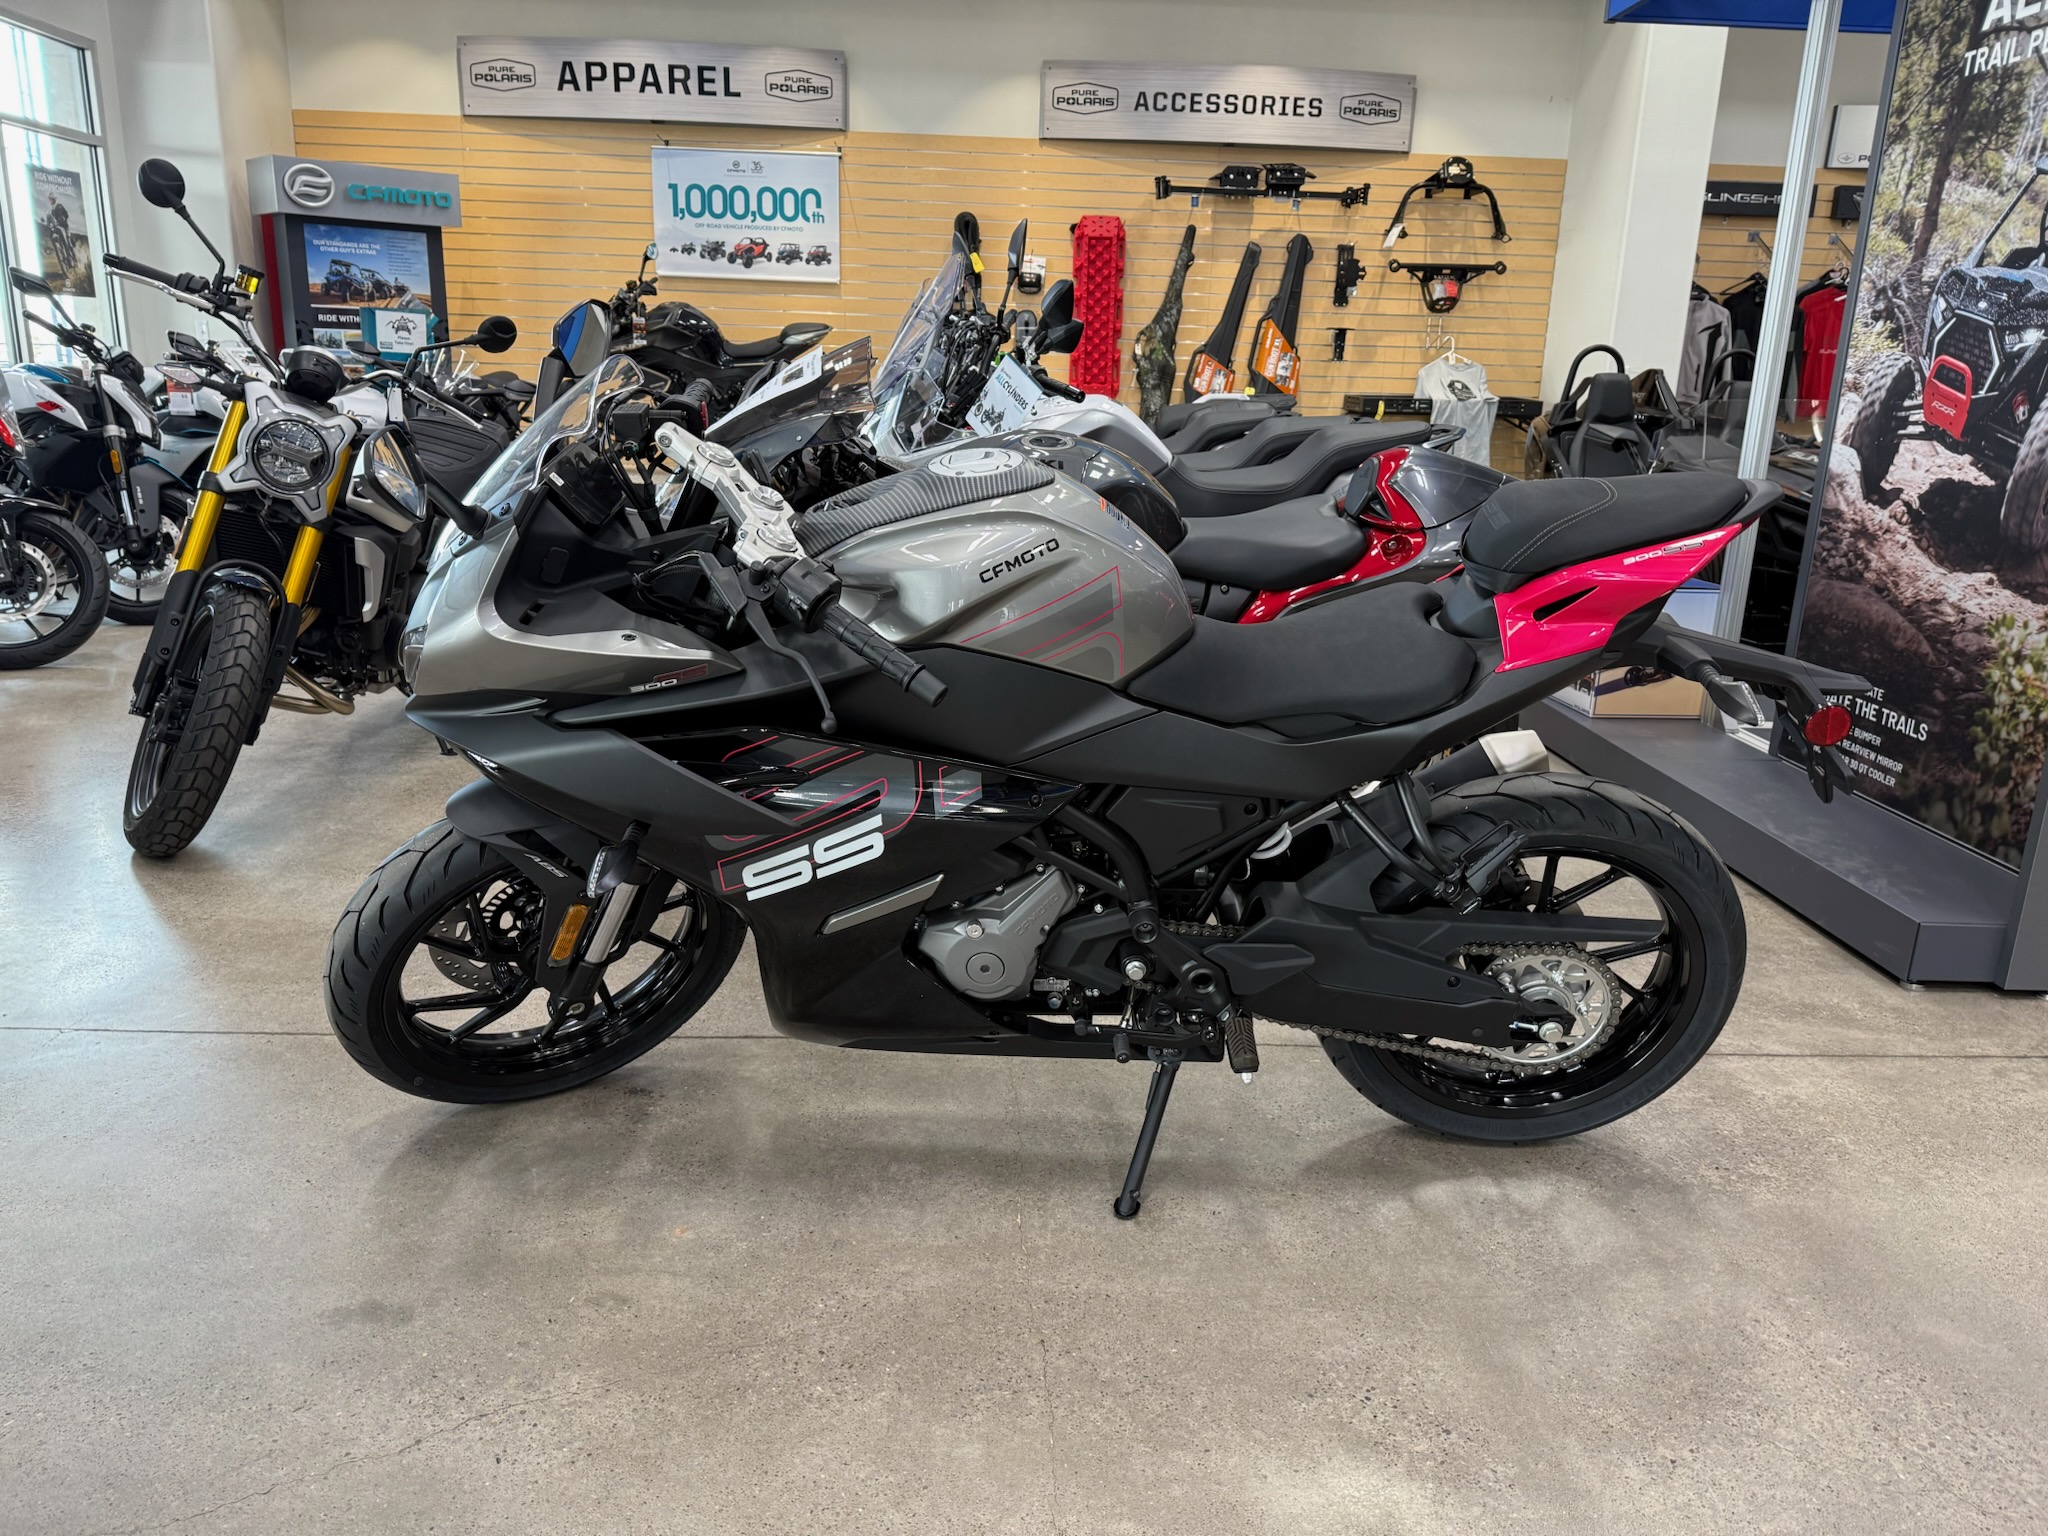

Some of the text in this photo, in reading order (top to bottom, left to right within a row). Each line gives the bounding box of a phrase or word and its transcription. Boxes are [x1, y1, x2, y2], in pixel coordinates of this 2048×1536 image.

[1964, 36, 2021, 77] TRAIL
[474, 72, 533, 84] POLARIS
[488, 65, 516, 74] PURE
[557, 61, 742, 98] APPAREL
[784, 75, 813, 84] PURE
[768, 83, 830, 96] POLARIS
[1071, 89, 1099, 97] PURE
[1056, 96, 1115, 107] POLARIS
[1133, 91, 1323, 118] ACCESSORIES
[1357, 99, 1384, 107] PURE
[1343, 106, 1398, 118] POLARIS
[348, 184, 452, 208] CFMOTO
[318, 313, 338, 322] RIDE
[979, 537, 1060, 584] CFMOTO
[630, 678, 678, 693] 300
[1855, 698, 1879, 722] THE
[1881, 708, 1928, 741] TRAILS
[1853, 728, 1882, 747] BUMPER
[1842, 739, 1878, 761] REARVIEW
[1876, 753, 1904, 774] MIRROR
[1849, 758, 1858, 770] 30
[1867, 767, 1896, 788] COOLER
[742, 813, 885, 902] SS
